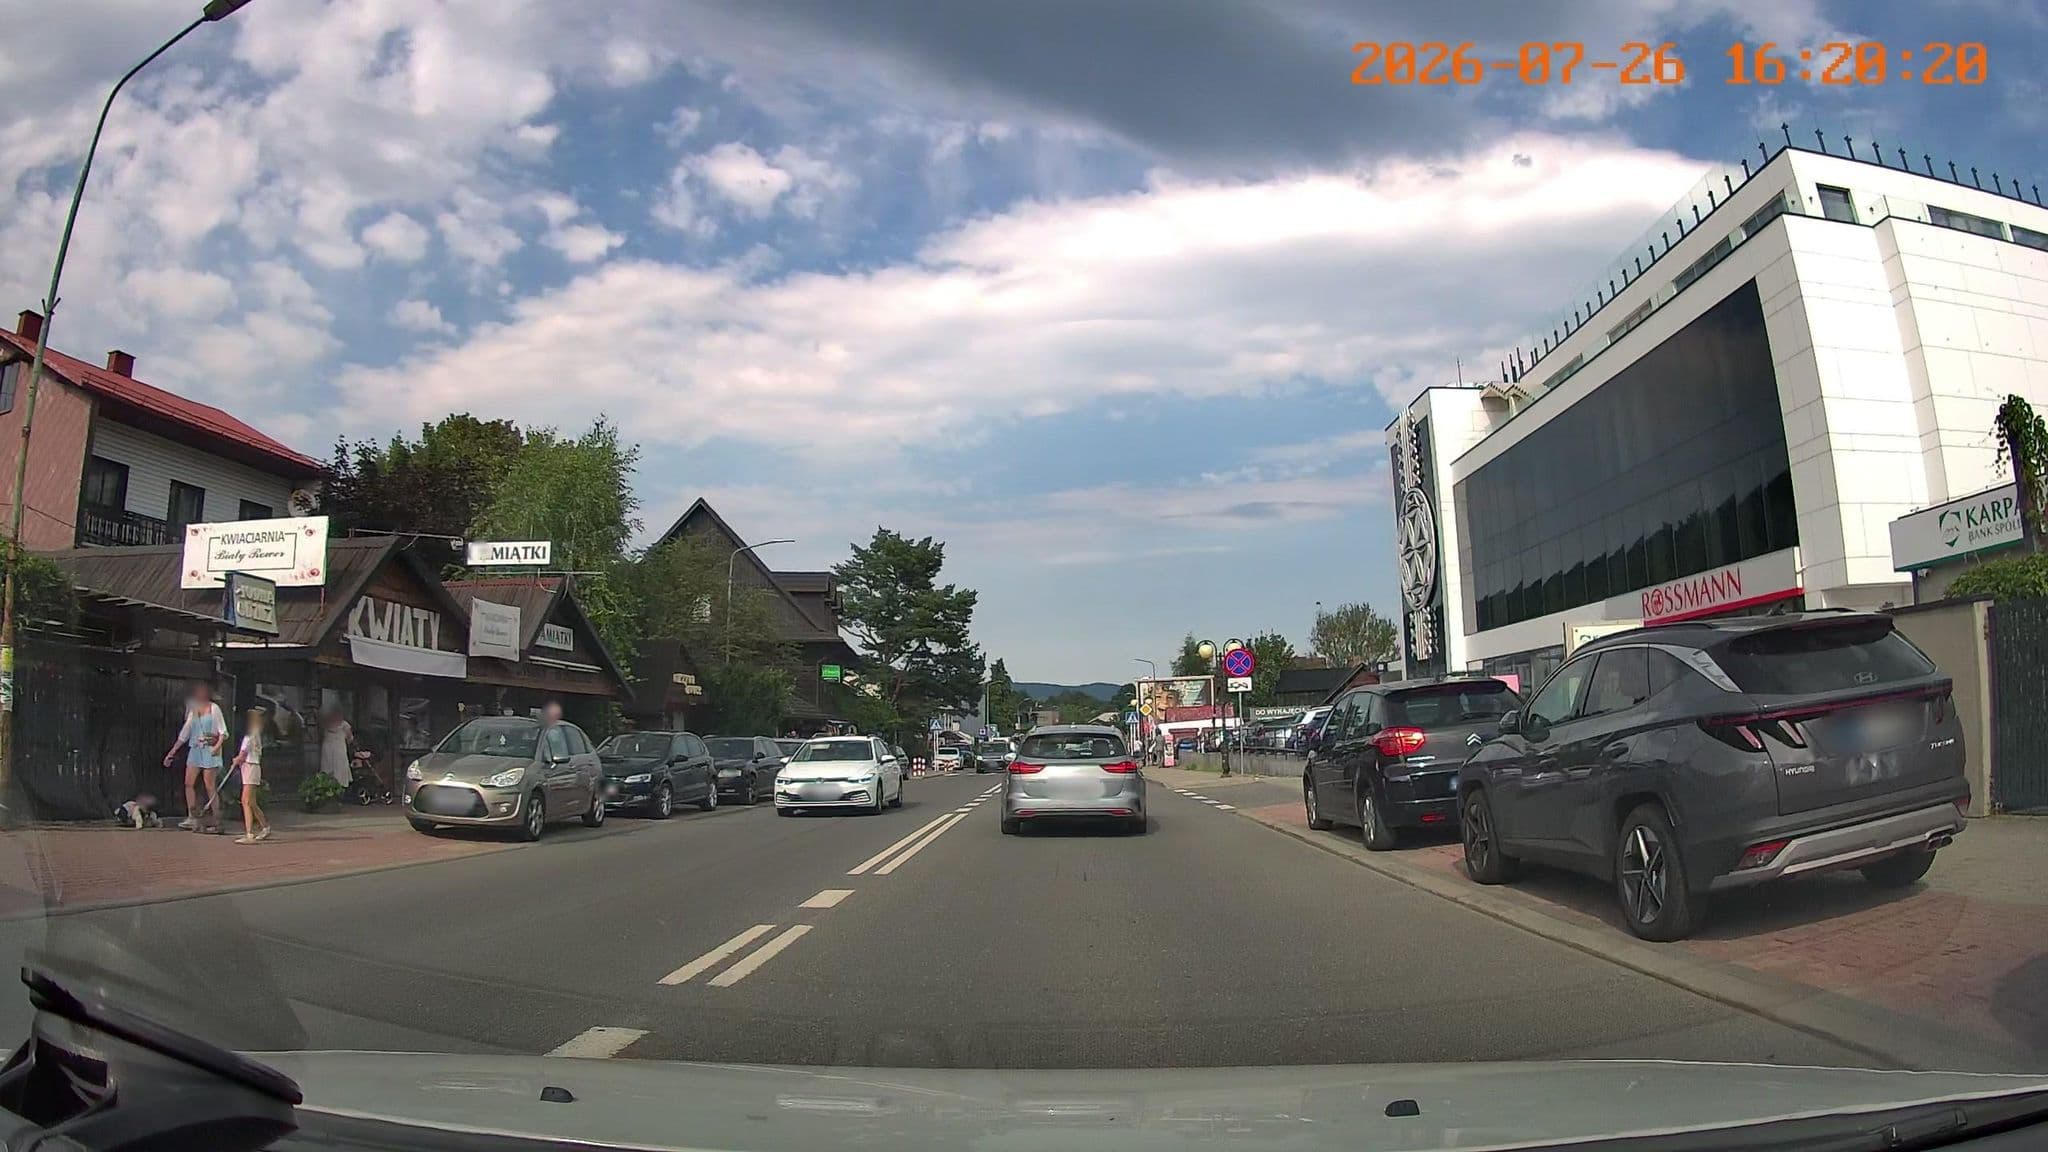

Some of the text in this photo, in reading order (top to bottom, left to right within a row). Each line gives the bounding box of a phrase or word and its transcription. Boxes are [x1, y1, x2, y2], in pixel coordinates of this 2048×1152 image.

[220, 531, 286, 545] KWIACIARNIA
[1968, 526, 1993, 542] BANK
[482, 546, 547, 563] MIĄTKI
[1641, 567, 1742, 617] ROSSMANN
[348, 595, 441, 650] KWIATY
